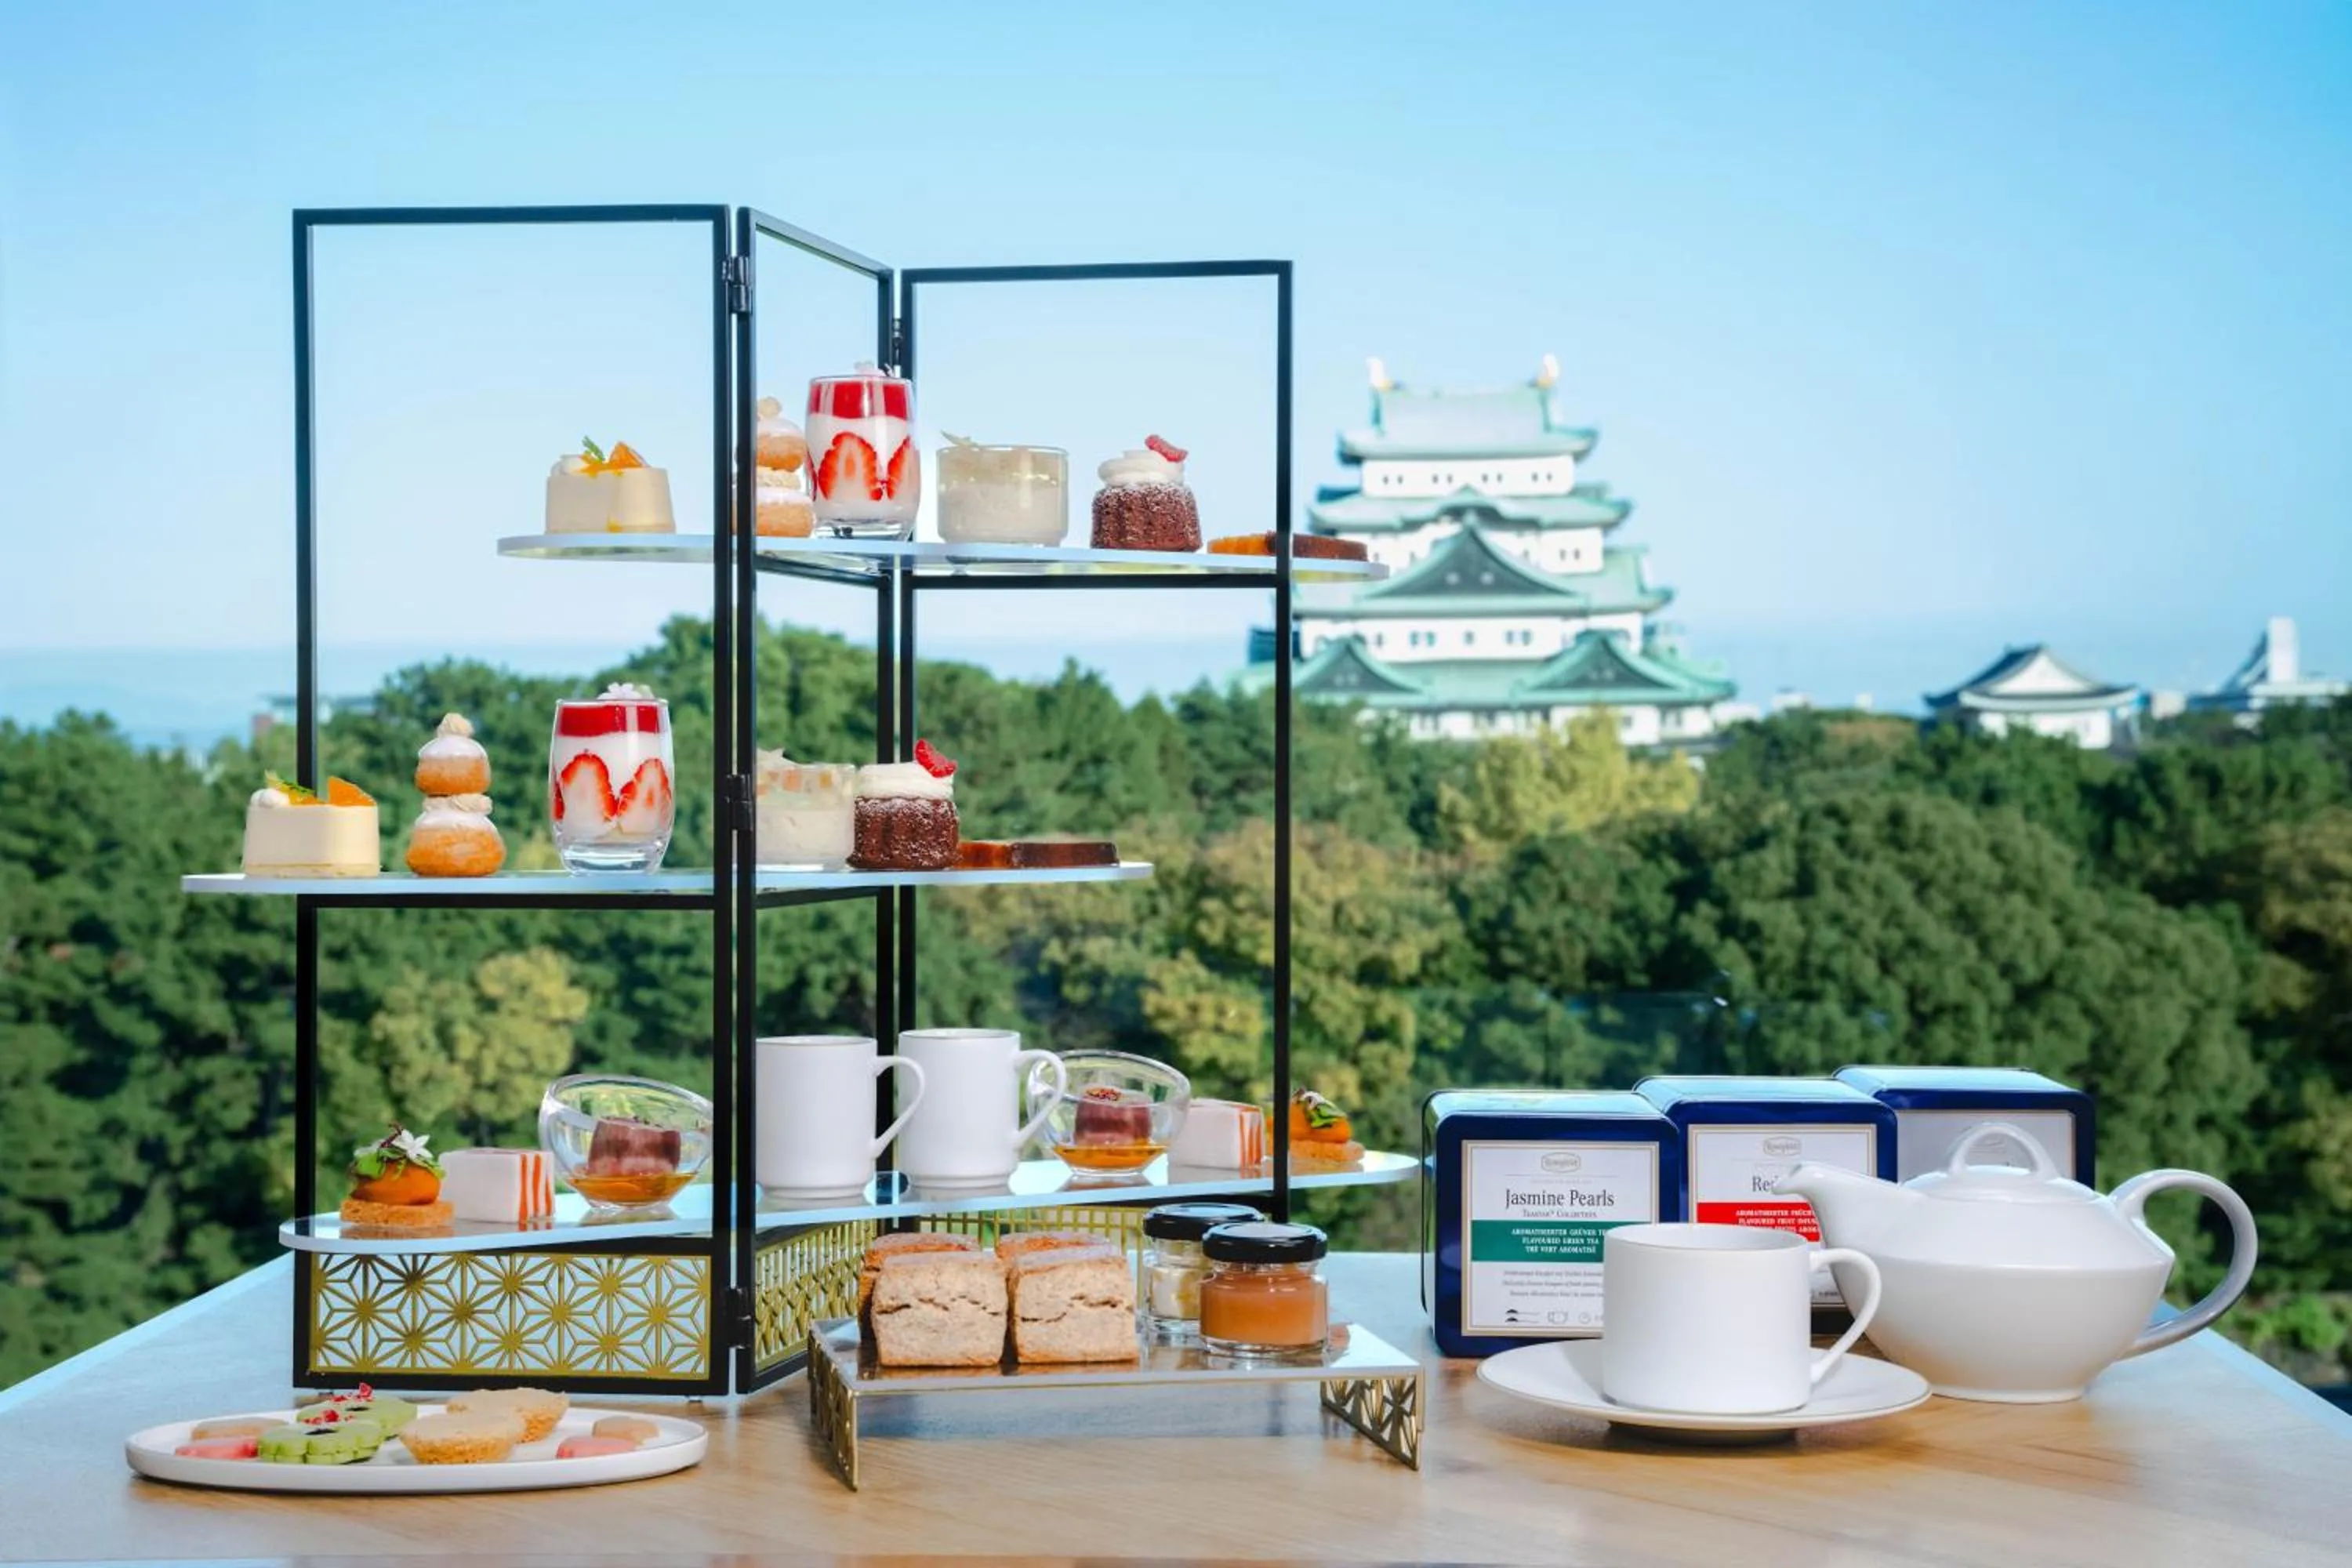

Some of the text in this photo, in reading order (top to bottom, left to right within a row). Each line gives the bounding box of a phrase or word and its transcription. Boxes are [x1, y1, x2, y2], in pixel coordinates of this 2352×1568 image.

[1505, 1188, 1615, 1209] Jasmine Pearls
[1569, 1227, 1596, 1236] GRÜNER
